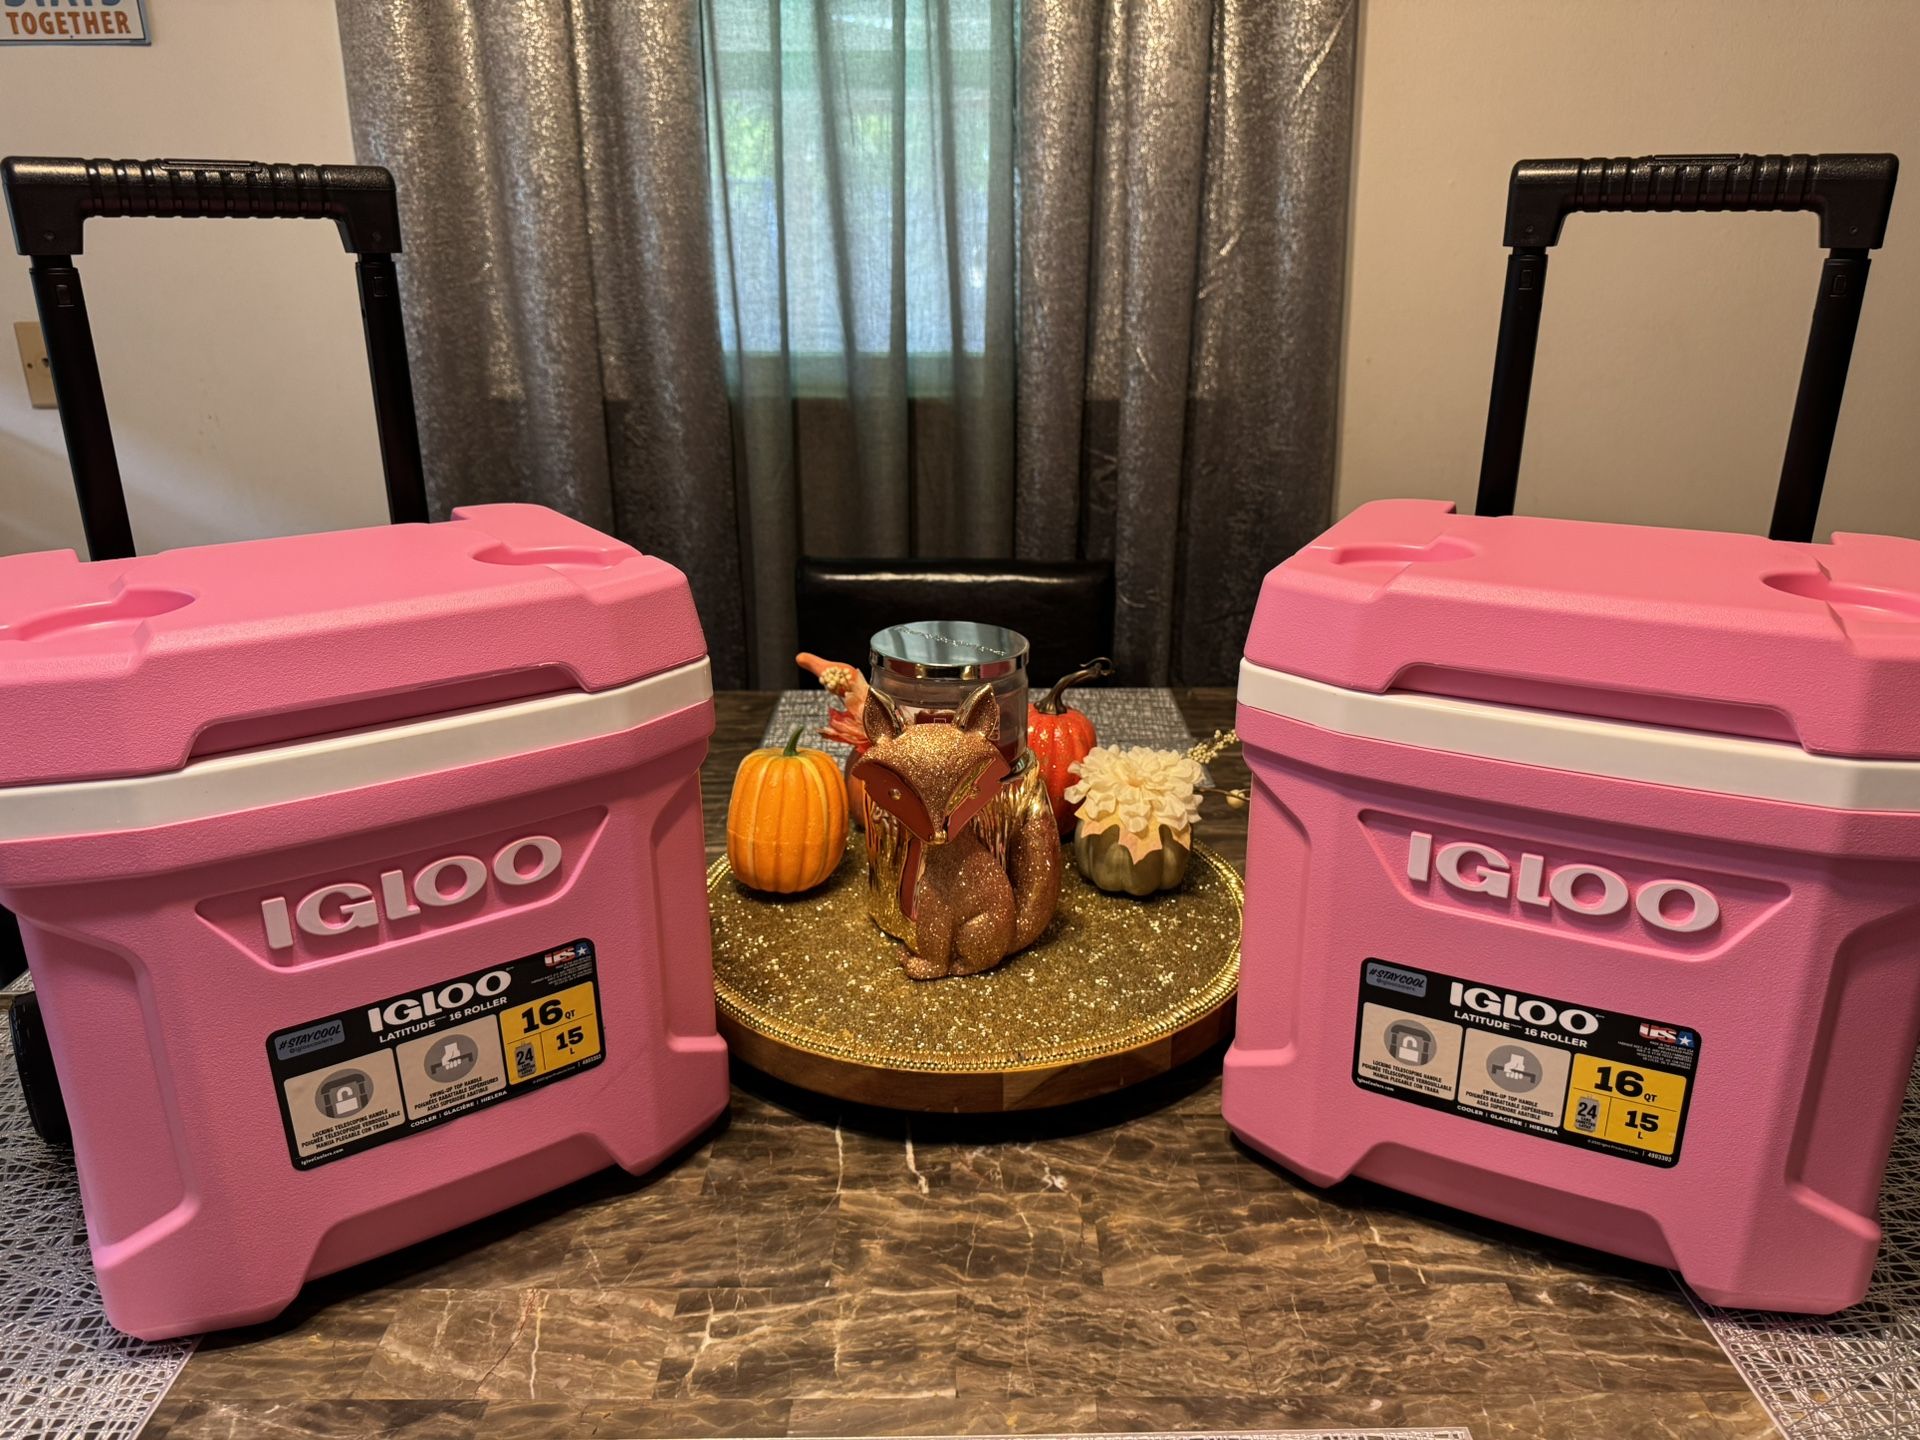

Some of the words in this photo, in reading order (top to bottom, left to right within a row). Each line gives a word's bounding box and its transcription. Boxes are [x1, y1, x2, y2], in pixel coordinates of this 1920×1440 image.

[6, 11, 131, 35] TOGETHER
[261, 835, 562, 949] IGLOO
[1407, 831, 1719, 932] IGLOO
[1369, 968, 1424, 988] #STAYCOOL
[368, 971, 511, 1032] IGLOO
[1450, 982, 1599, 1035] IGLOO
[379, 1019, 436, 1043] LATITUDE
[450, 1012, 462, 1021] 16
[464, 996, 507, 1015] ROLLER
[521, 999, 563, 1033] 16
[565, 1009, 575, 1019] QT
[1454, 1010, 1510, 1030] LATITUDE
[1524, 1027, 1538, 1037] 16
[1540, 1030, 1588, 1048] ROLLER
[279, 1024, 341, 1050] #STAYCOOL
[556, 1026, 584, 1050] 15
[516, 1048, 533, 1066] 24
[1372, 1059, 1391, 1069] LOCKING
[1393, 1065, 1422, 1077] TELESCOPING
[1424, 1073, 1442, 1083] HANDLE
[1594, 1066, 1644, 1097] 16
[1644, 1093, 1657, 1102] QT
[429, 1086, 453, 1098] SWING-UP
[464, 1076, 483, 1086] HANDLE
[1483, 1089, 1507, 1099] SWING-UP
[1518, 1098, 1538, 1107] HANDLE
[410, 1115, 437, 1128] COOLER
[443, 1102, 475, 1116] GLACIÈRE
[480, 1090, 508, 1103] HIELERA
[1456, 1105, 1484, 1116] COOLER
[1490, 1114, 1522, 1126] GLACIÈRE
[1529, 1123, 1558, 1135] HIELERA
[1577, 1102, 1597, 1119] 24
[1625, 1110, 1659, 1132] 15
[312, 1127, 334, 1138] LOCKING
[335, 1116, 368, 1130] TELESCOPING
[368, 1109, 389, 1119] HANDLE
[361, 1126, 372, 1134] CON
